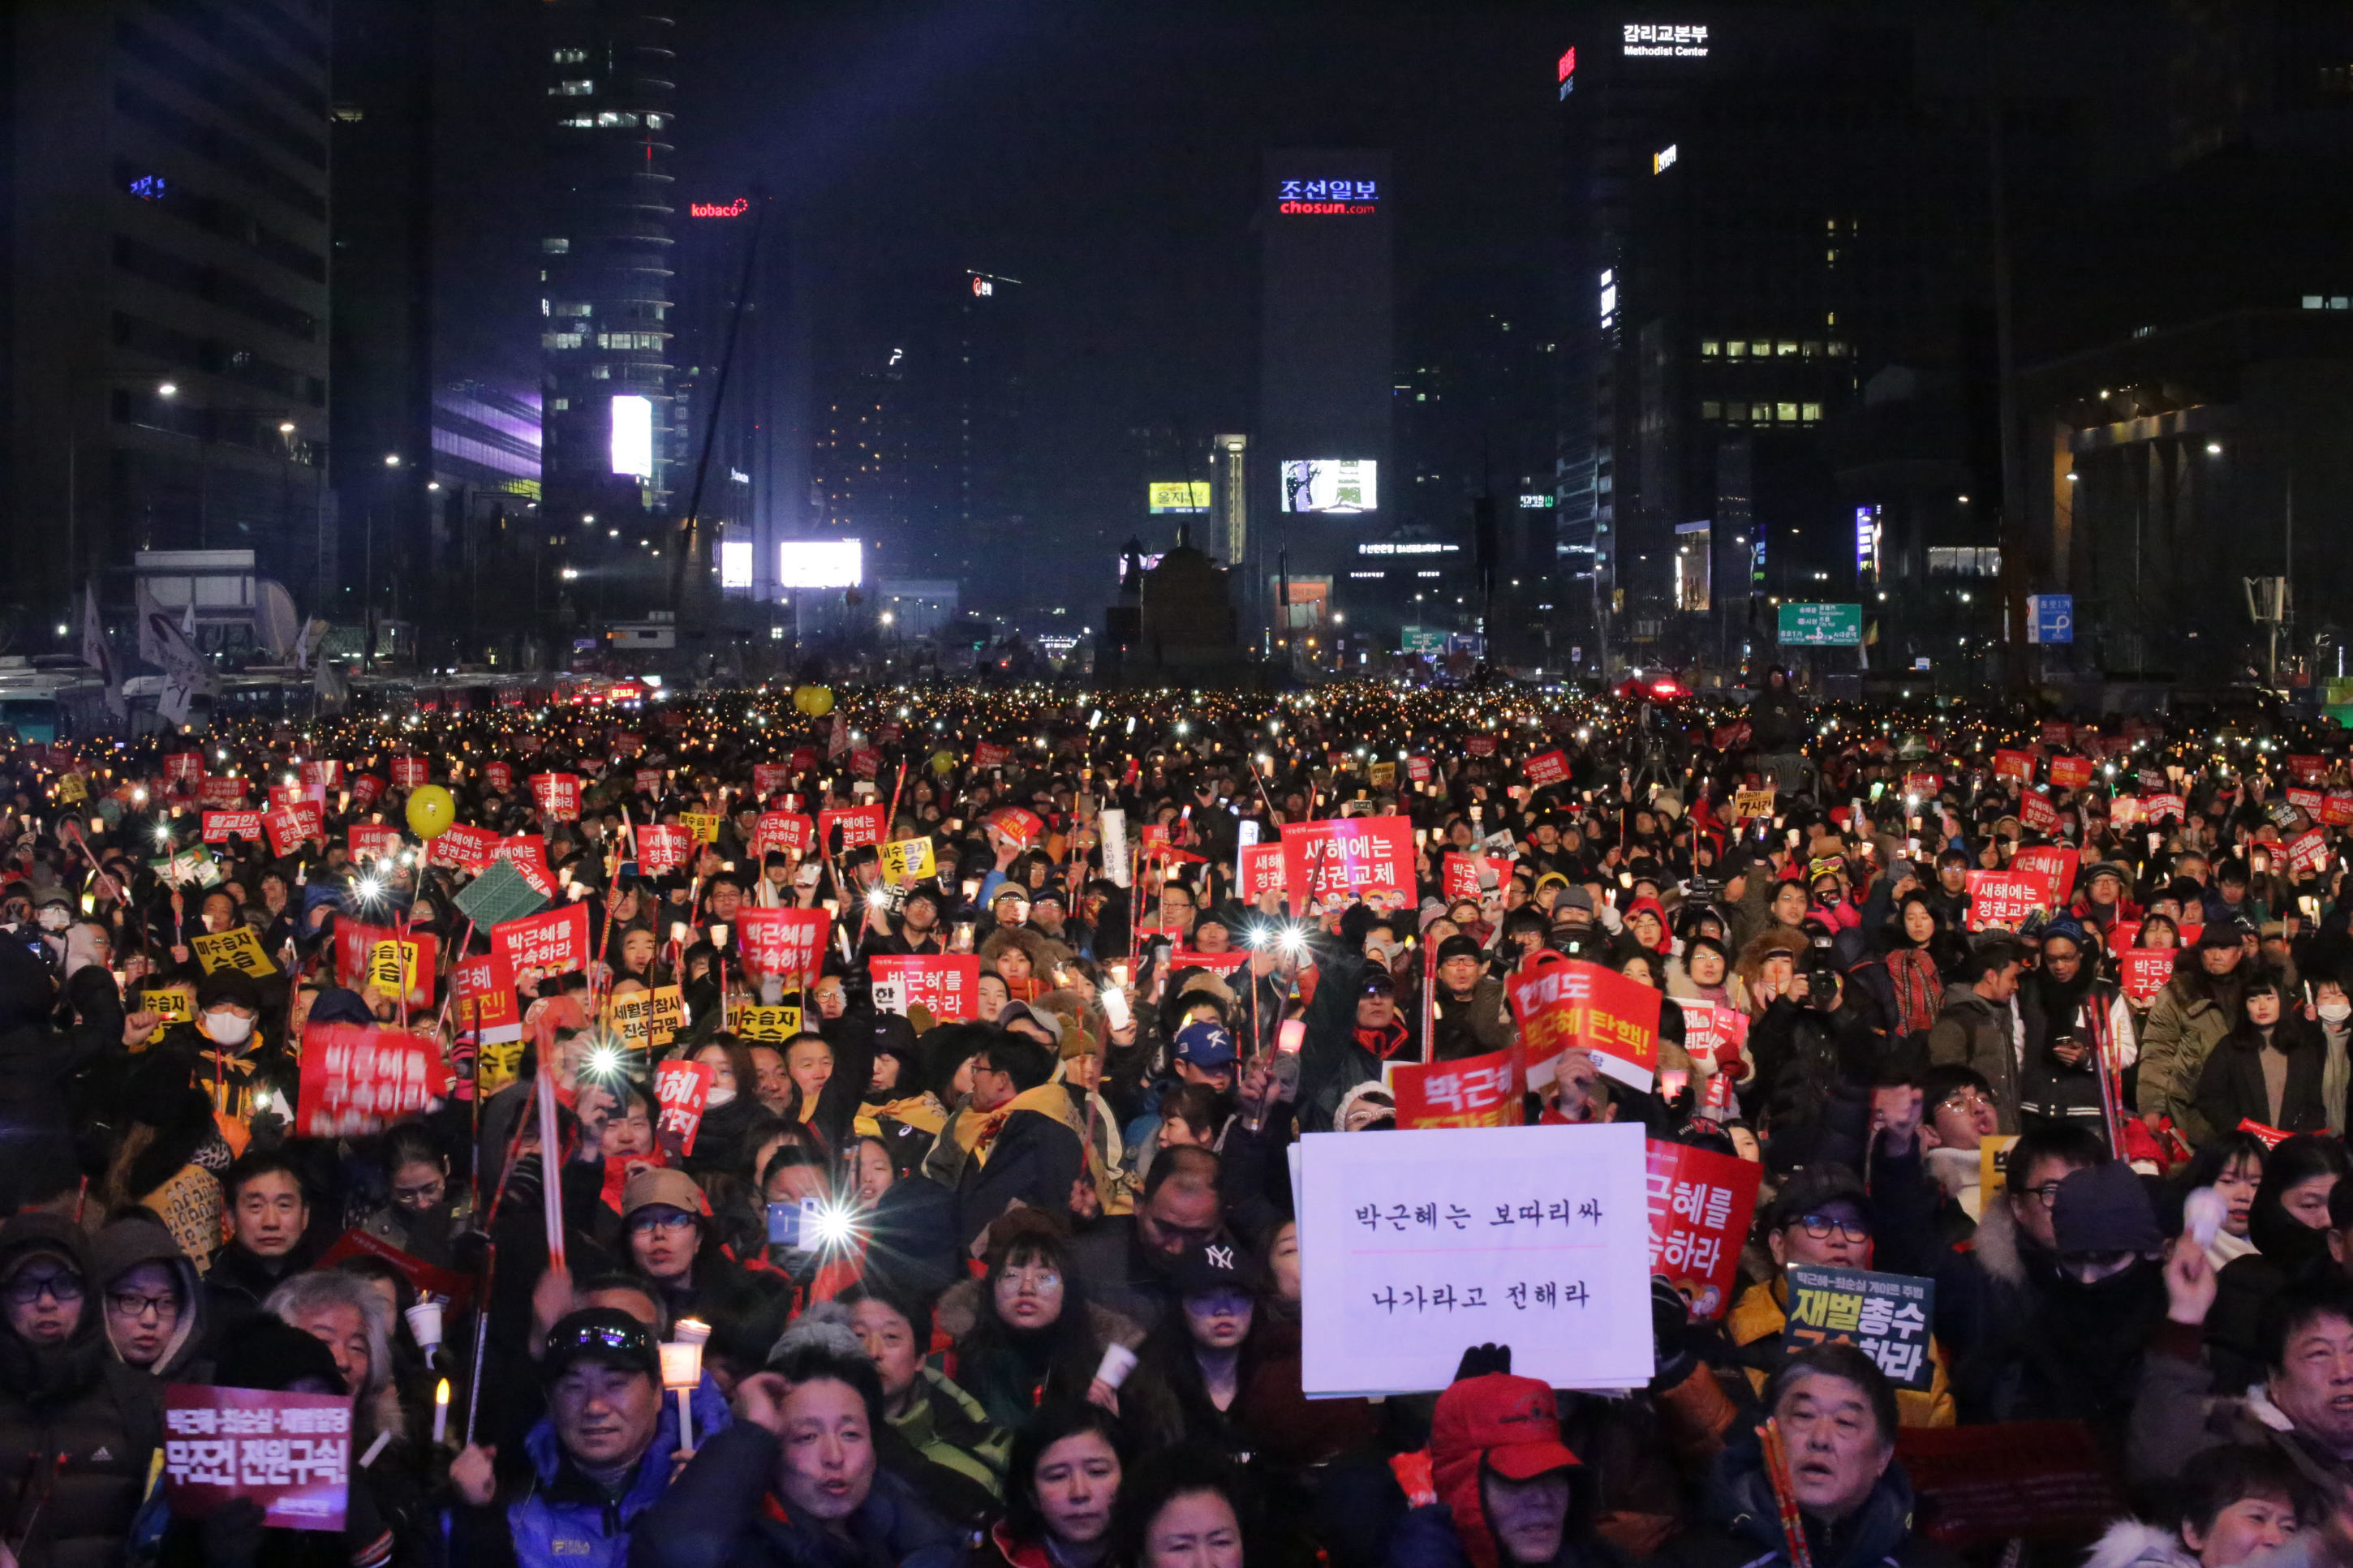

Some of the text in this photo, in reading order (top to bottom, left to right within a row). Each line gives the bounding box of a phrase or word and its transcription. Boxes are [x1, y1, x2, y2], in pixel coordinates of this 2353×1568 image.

[1624, 24, 1708, 43] 감리교본부
[1624, 46, 1708, 57] Methodist Center
[1279, 180, 1379, 200] 조선일보
[691, 204, 738, 217] kobaco
[1280, 201, 1375, 214] chosun.com
[1528, 757, 1558, 772] 박근혜를
[1531, 767, 1561, 780] 구속하라
[536, 783, 574, 796] 박근혜를
[539, 797, 574, 808] 구속하라
[2028, 798, 2056, 815] 새해에는
[209, 814, 260, 827] 황교안,
[276, 810, 316, 828] 새해에는
[759, 818, 800, 832] 박근혜를
[2027, 809, 2054, 824] 정권교체
[280, 823, 319, 842] 정권교체
[438, 829, 484, 850] 새해에는
[649, 836, 689, 848] 새해에는
[760, 830, 800, 844] 구속하라
[843, 831, 876, 843] 권교체
[437, 842, 484, 860] 정권교체
[489, 844, 536, 860] 새해에는
[881, 840, 929, 858] 미수습자
[1304, 835, 1393, 860] 새해에는
[890, 857, 923, 874] 수습
[1255, 853, 1284, 870] 새해
[1255, 872, 1287, 887] 정권
[1306, 862, 1396, 891] 정권교체
[1978, 882, 2037, 900] 새해에는
[196, 932, 252, 956] 미수습자
[507, 920, 571, 949] 박근혜를
[746, 922, 816, 947] 박근혜를
[510, 941, 572, 972] 구속하라
[749, 947, 813, 970] 구속하라
[457, 964, 490, 996] 근혜
[888, 970, 963, 991] 박근혜를
[2134, 978, 2165, 994] 구속
[1516, 972, 1591, 1016] 헌재도
[613, 995, 681, 1020] 세월호참사
[622, 1016, 678, 1039] 진상규명
[727, 1010, 796, 1026] 미수습자
[1525, 1007, 1651, 1056] 박근혜 탄핵!
[654, 1071, 701, 1109] 혜,
[1423, 1062, 1513, 1112] 박근혜
[1645, 1171, 1732, 1231] 근혜를
[1355, 1197, 1603, 1231] 박근혜는 보따리싸
[1371, 1280, 1590, 1315] 나가라고 전해라
[1869, 1280, 1900, 1296] 게이트
[1903, 1283, 1925, 1300] 주범
[1790, 1287, 1926, 1340] 재벌총수
[166, 1439, 236, 1485] 무조건
